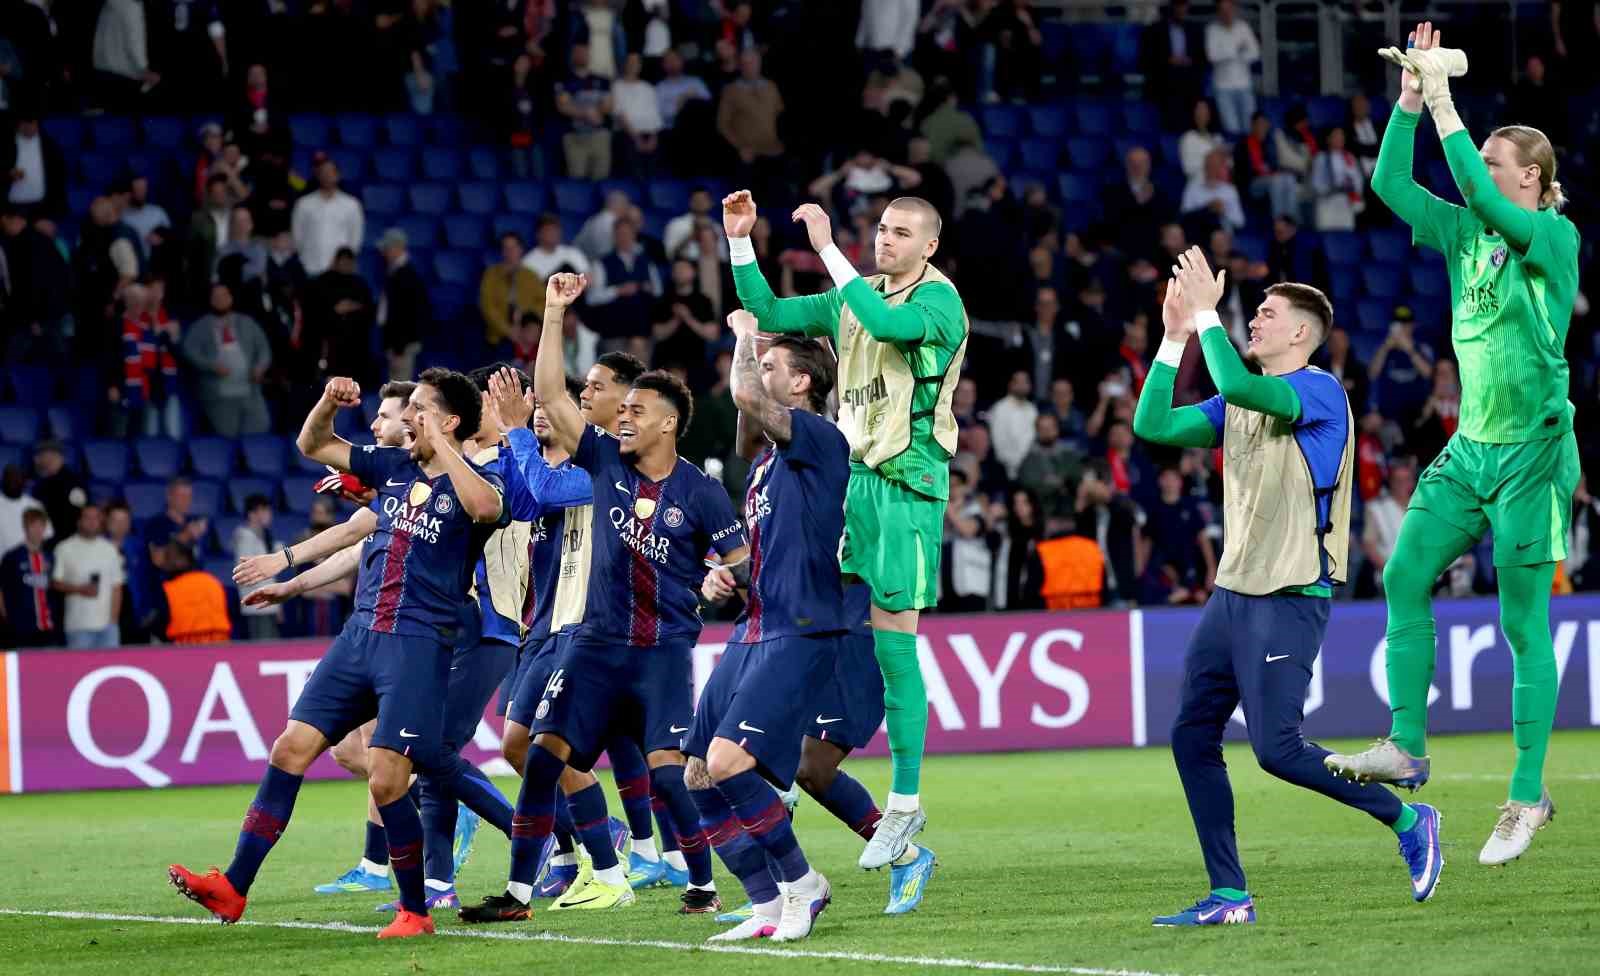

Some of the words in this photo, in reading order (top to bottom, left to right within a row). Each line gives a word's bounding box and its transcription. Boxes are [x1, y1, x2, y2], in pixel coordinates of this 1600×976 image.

[390, 516, 439, 544] AIRWAYS
[711, 519, 743, 542] BEYON
[619, 531, 668, 565] AIRWAYS
[541, 668, 565, 699] 14
[66, 660, 323, 788] QAT
